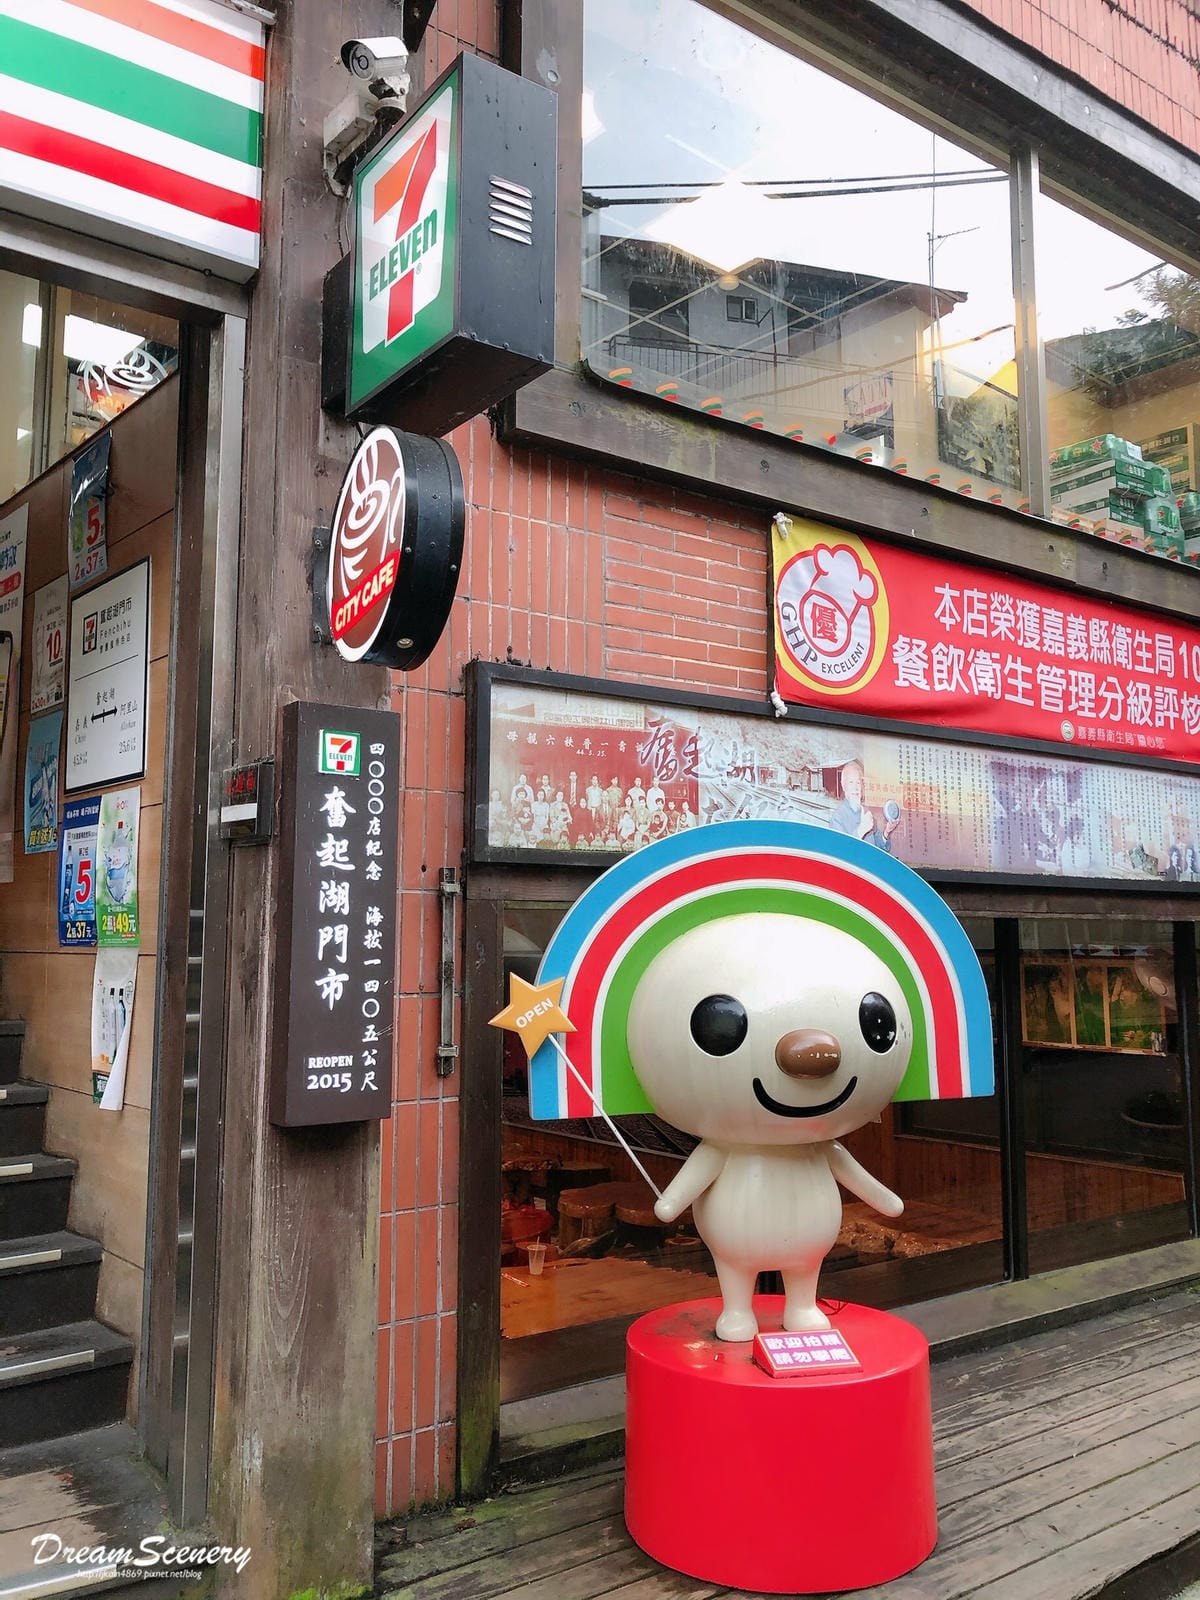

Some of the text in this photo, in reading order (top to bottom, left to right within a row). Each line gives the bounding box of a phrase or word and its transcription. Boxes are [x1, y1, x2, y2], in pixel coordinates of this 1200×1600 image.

[86, 504, 100, 545] 5
[336, 558, 395, 632] CITY CAFE
[781, 602, 818, 666] GHP
[811, 602, 838, 644] 優
[821, 642, 865, 674] EXCELLENT
[892, 634, 1200, 735] 餐飲衛生管理分級評核
[75, 859, 92, 904] 5
[315, 786, 357, 1011] 奮起湖門市
[516, 998, 554, 1028] OPEN
[307, 1073, 352, 1093] 2015
[308, 1055, 354, 1069] REOPEN
